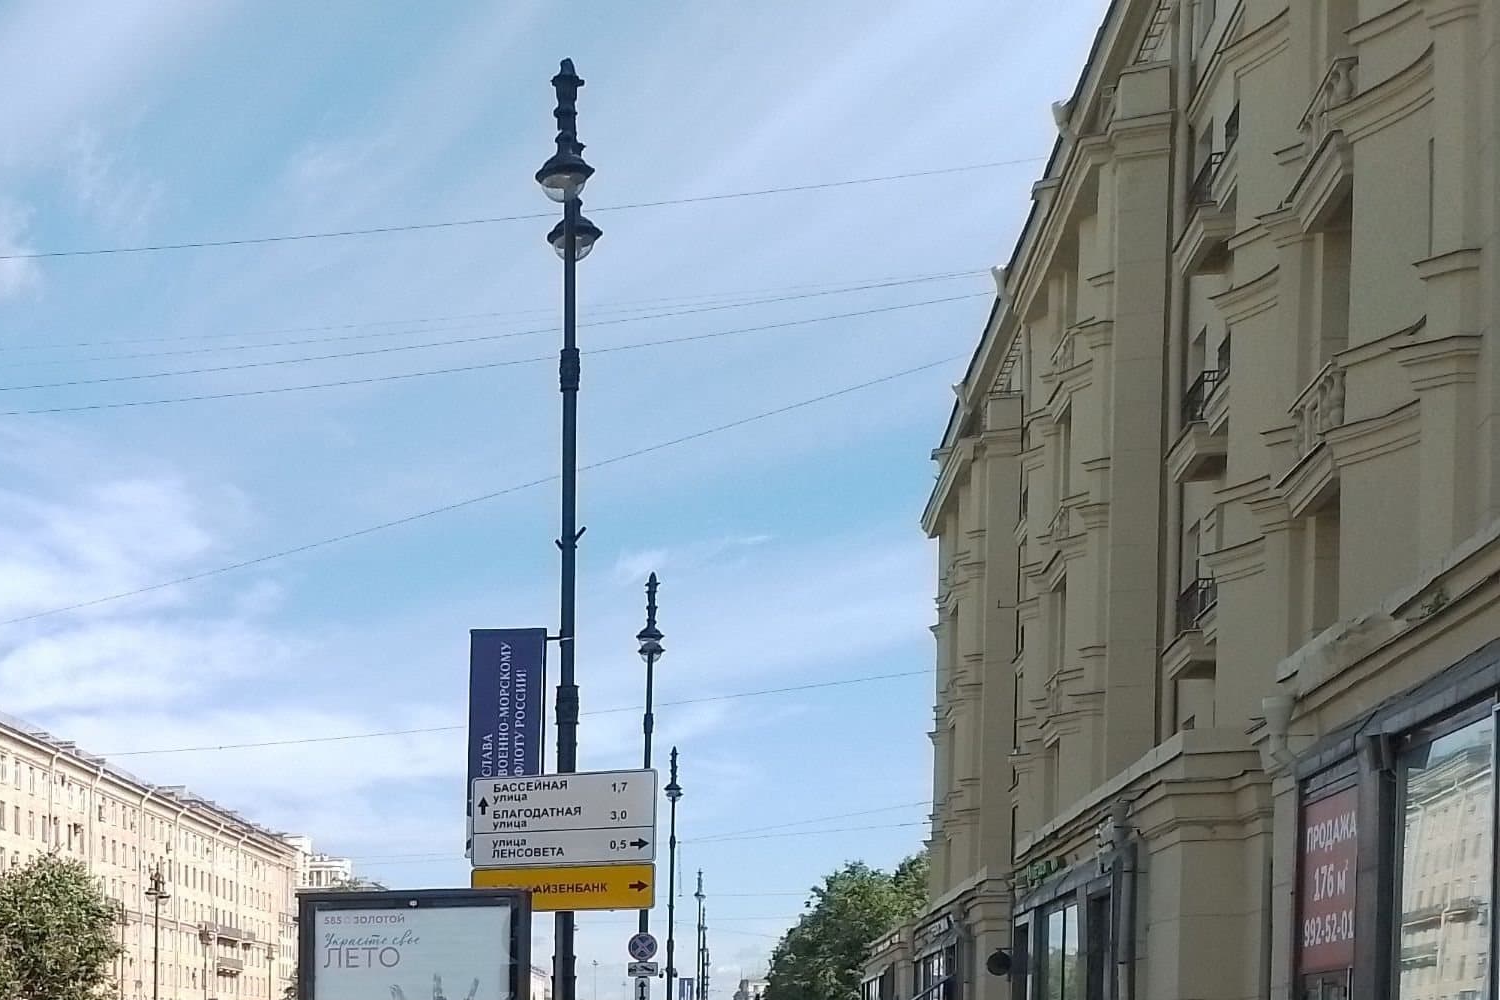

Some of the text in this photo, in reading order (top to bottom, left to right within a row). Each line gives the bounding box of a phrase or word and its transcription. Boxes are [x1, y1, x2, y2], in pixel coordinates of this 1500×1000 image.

[498, 641, 512, 777] ВОЕННО-МОРСКОМУ
[482, 733, 493, 777] СЛАВА
[514, 731, 525, 777] ФЛОТУ
[493, 780, 628, 793] БАССЕЙНАЯ 1,7
[493, 793, 528, 803] улица
[492, 806, 627, 822] БЛАГОДАТНАЯ 3,0
[492, 820, 528, 830] улица
[1306, 810, 1357, 854] ПРОДАЖА
[492, 838, 627, 851] улица 0,5
[492, 847, 565, 859] ЛЕНСОВЕТА
[532, 882, 608, 894] АЙЗЕНБАНК
[1314, 863, 1335, 901] 176
[324, 913, 405, 925] 585 ЗОЛОТОЙ
[1304, 910, 1354, 947] 992-52-01
[323, 946, 400, 968] ЛЕТО
